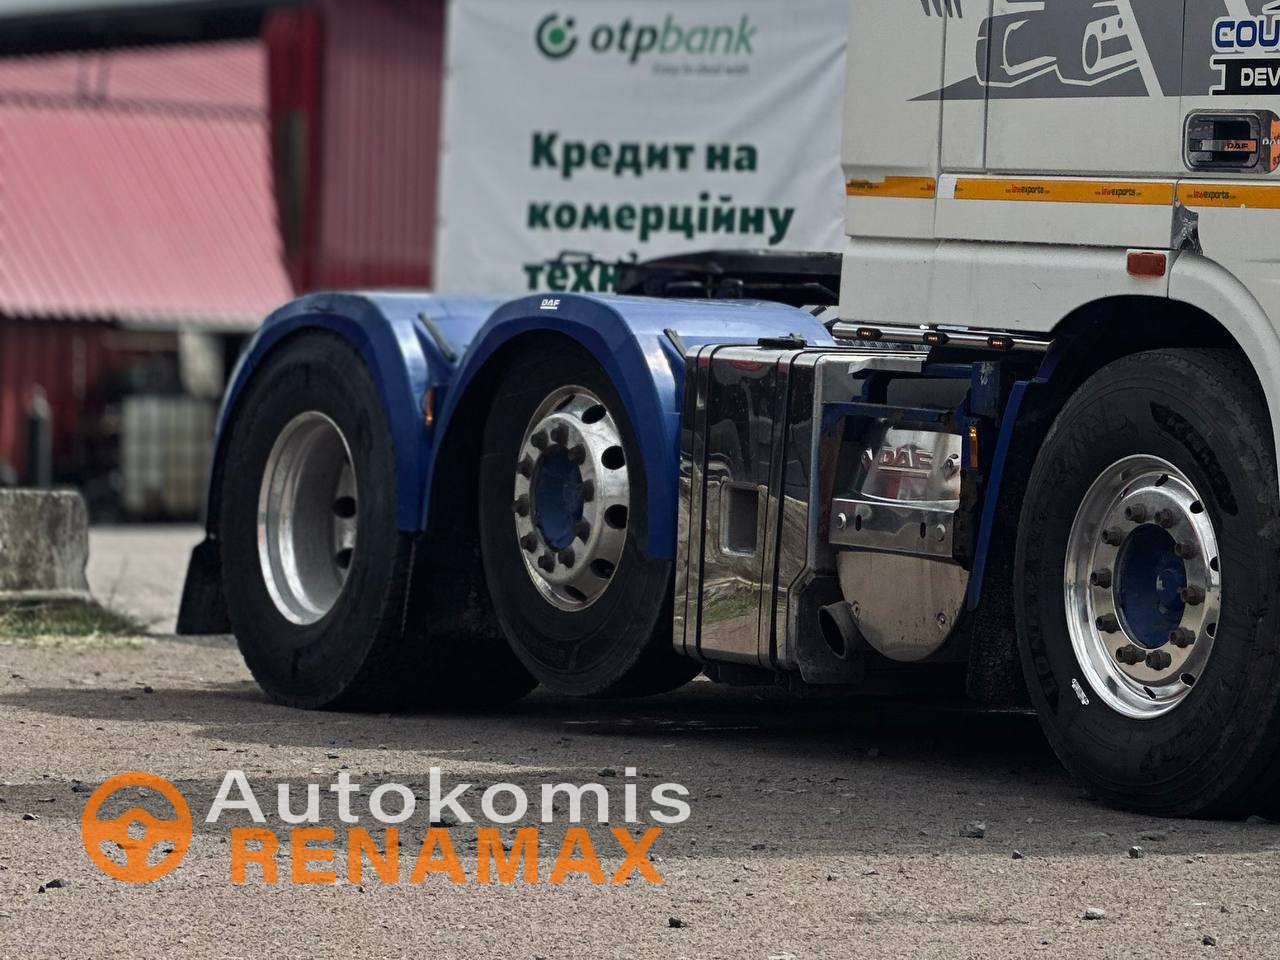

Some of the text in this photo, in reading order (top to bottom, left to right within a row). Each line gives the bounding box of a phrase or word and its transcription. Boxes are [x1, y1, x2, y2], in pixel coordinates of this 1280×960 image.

[589, 13, 756, 65] otpbank
[530, 131, 758, 179] Кредит на
[526, 192, 796, 246] комерційну
[523, 252, 638, 294] техн
[879, 446, 934, 470] DAF
